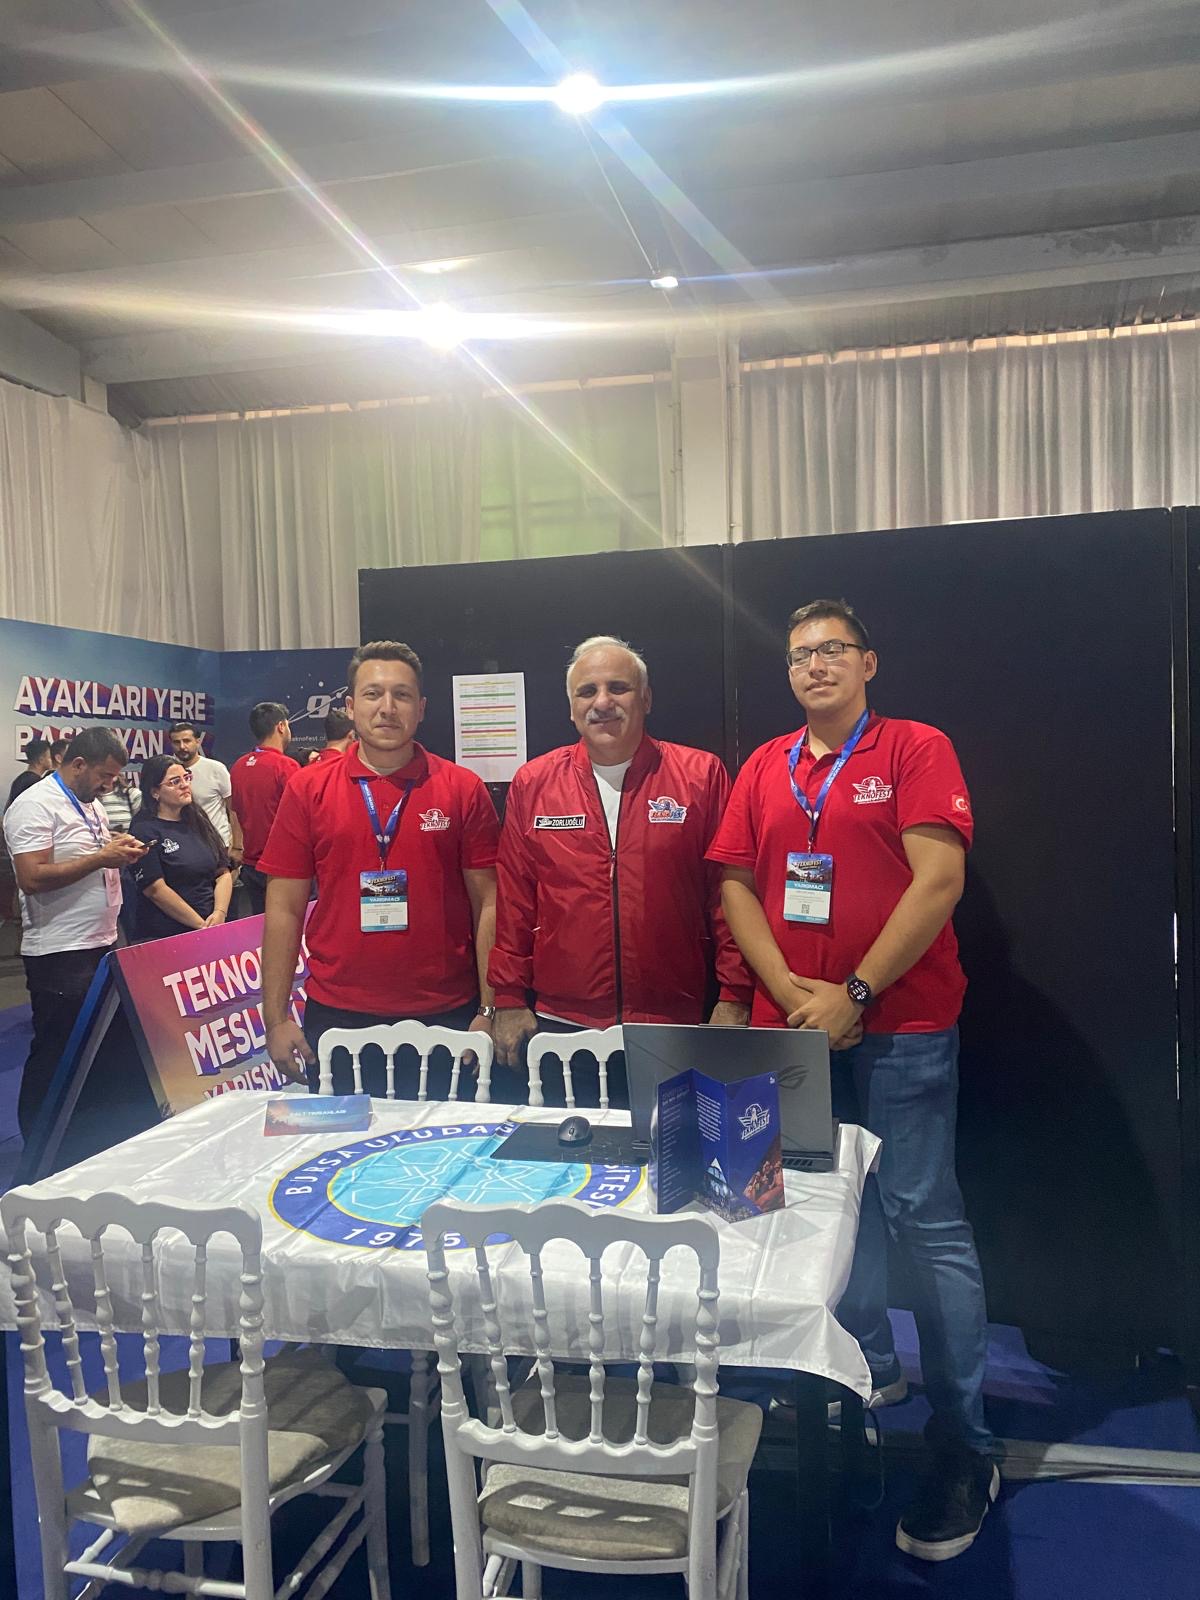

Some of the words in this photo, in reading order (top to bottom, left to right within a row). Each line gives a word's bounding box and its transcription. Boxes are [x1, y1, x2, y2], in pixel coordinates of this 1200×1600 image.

[13, 675, 147, 718] AYAKLARI
[153, 687, 206, 721] YERE
[853, 789, 893, 803] TEKNOFEST
[285, 1147, 361, 1196] BURSA
[342, 1226, 461, 1248] 1975
